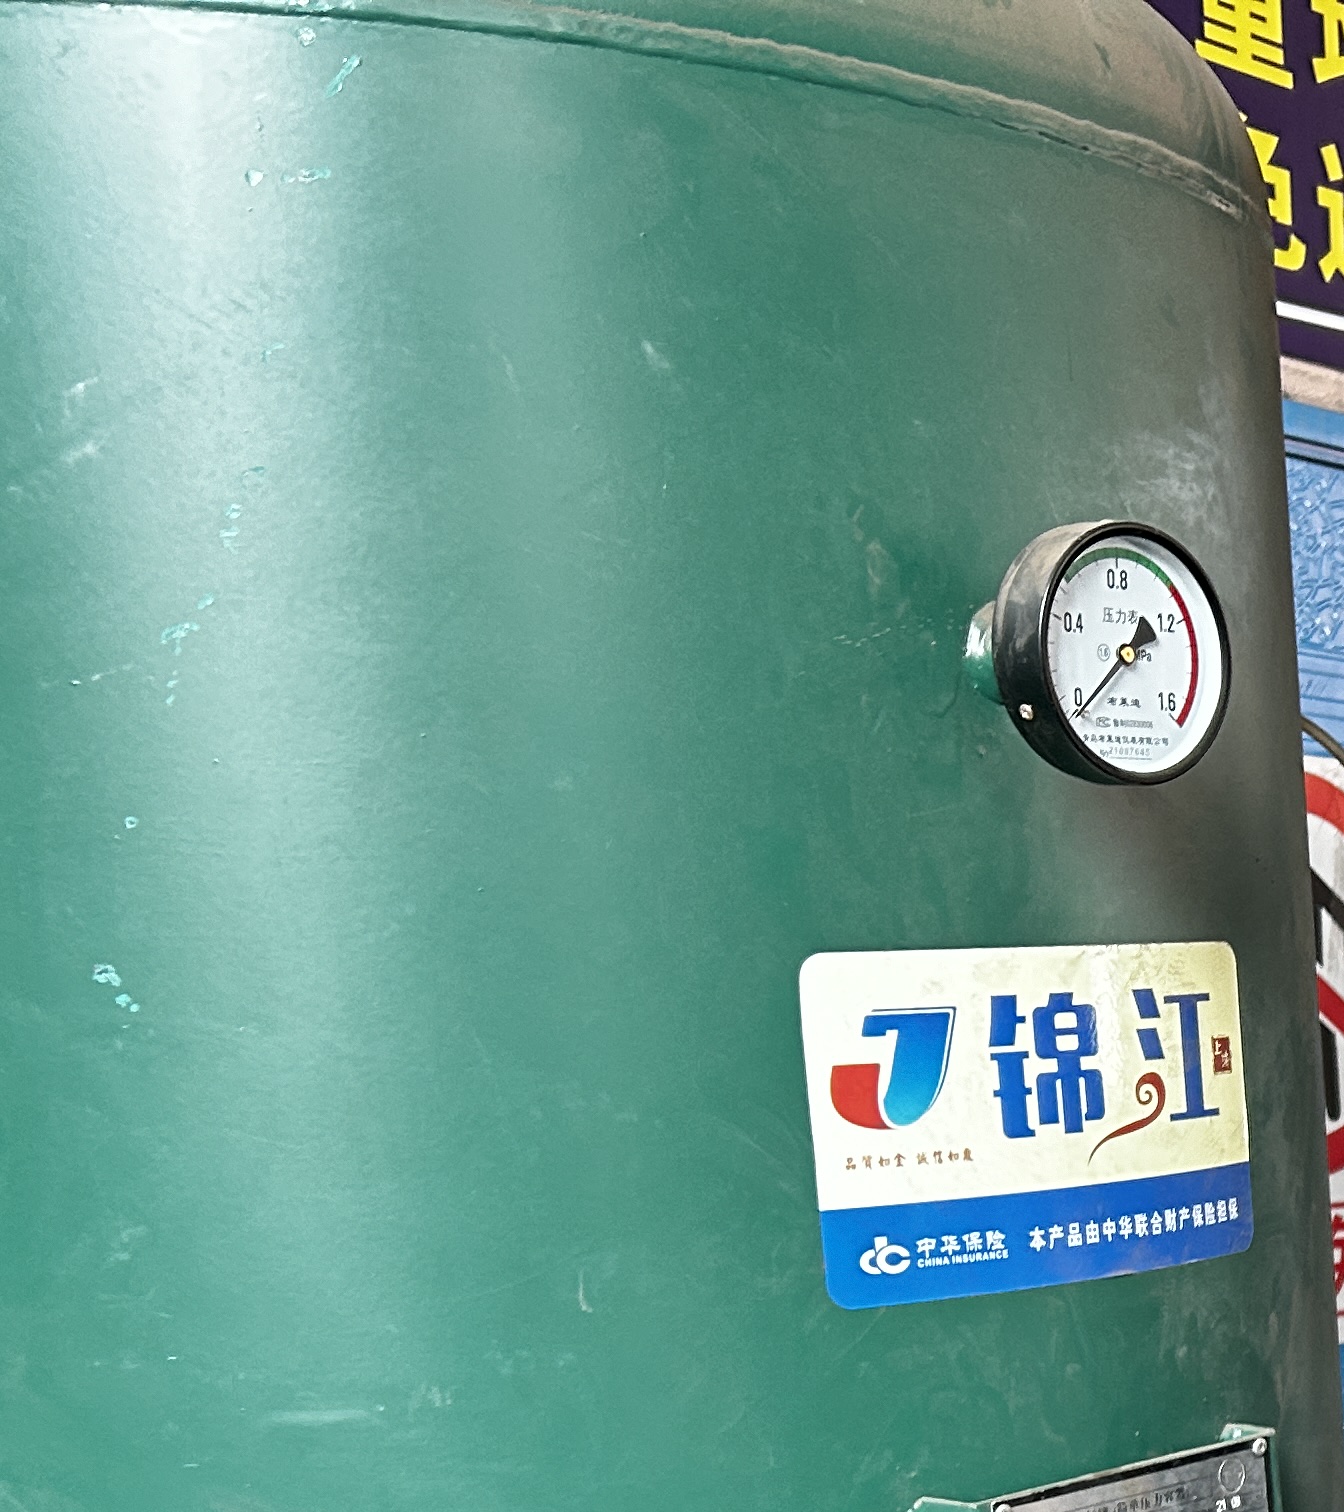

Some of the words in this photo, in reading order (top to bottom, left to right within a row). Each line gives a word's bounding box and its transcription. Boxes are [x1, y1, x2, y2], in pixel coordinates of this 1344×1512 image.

[1106, 569, 1128, 590] 0.8
[1063, 613, 1084, 633] 0.4
[1102, 607, 1138, 625] 压力表
[1157, 613, 1175, 633] 1.2
[1074, 687, 1083, 707] 0
[1158, 692, 1176, 712] 1.6
[988, 988, 1220, 1150] 锦江
[915, 1229, 1006, 1259] 中华保险
[917, 1256, 950, 1269] CHINA
[951, 1249, 1009, 1265] INSURANCE
